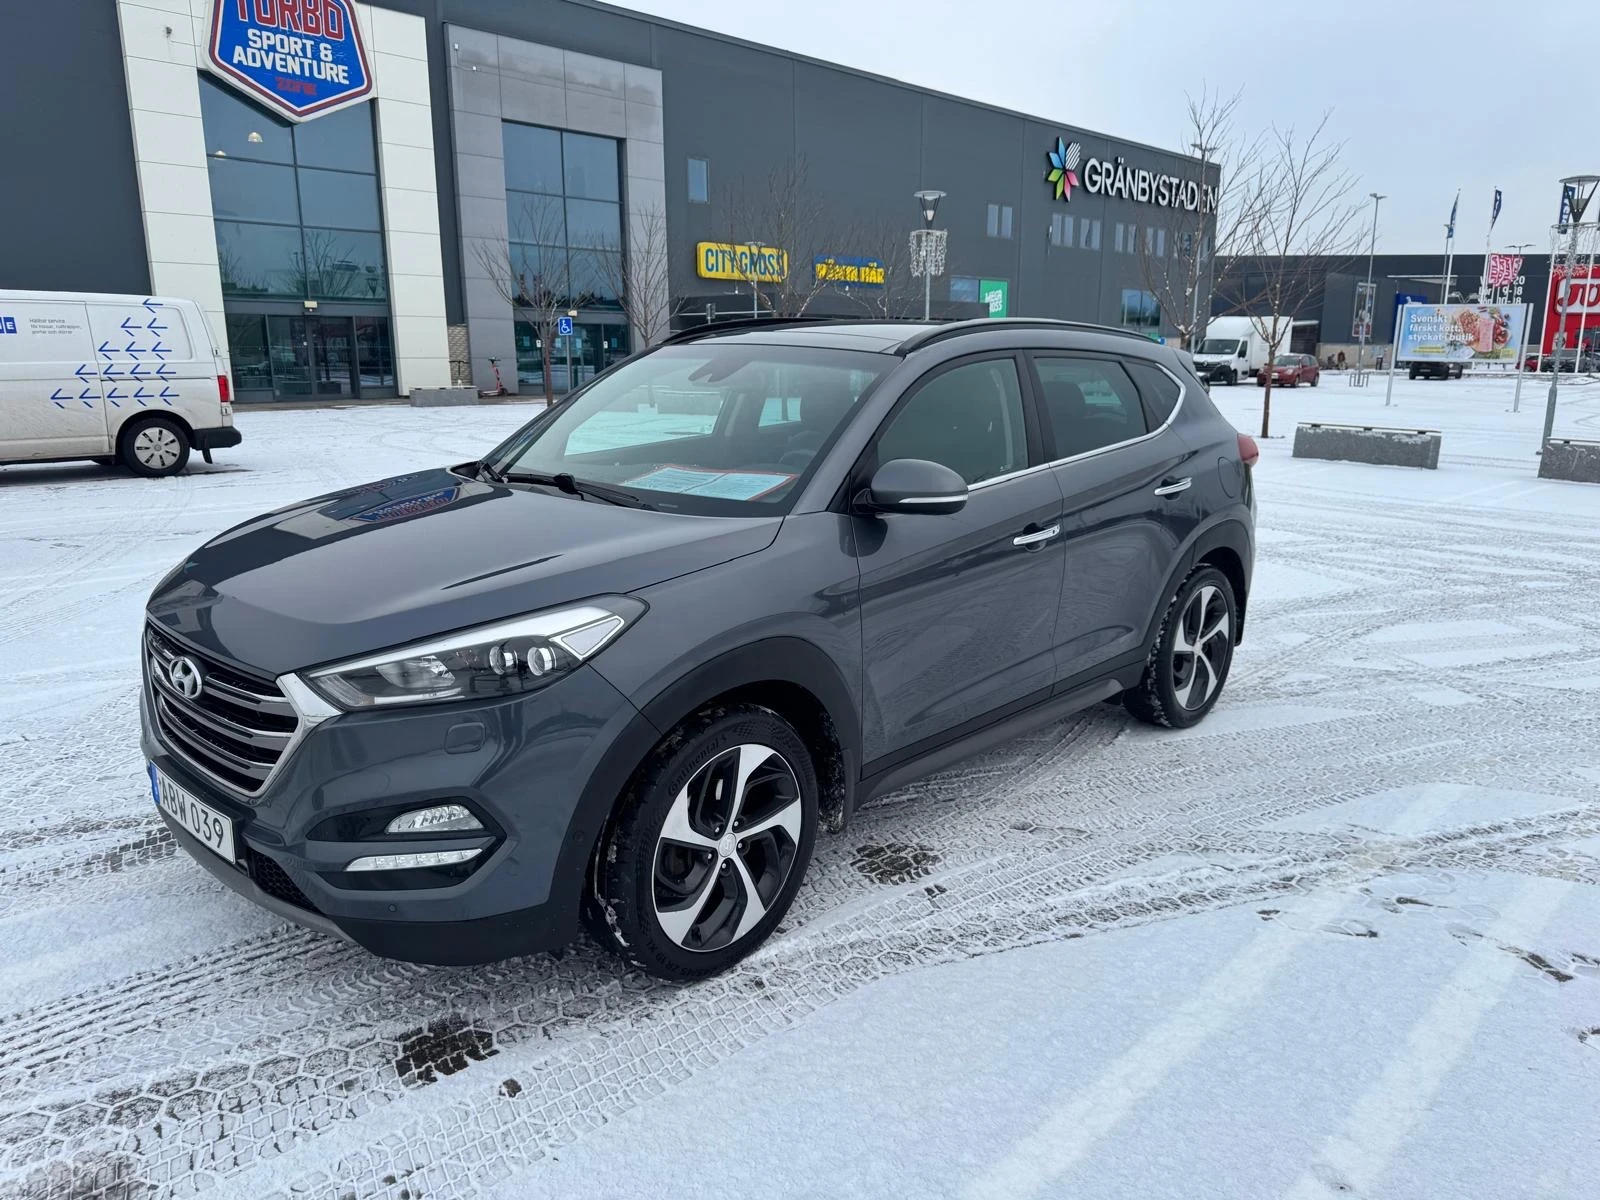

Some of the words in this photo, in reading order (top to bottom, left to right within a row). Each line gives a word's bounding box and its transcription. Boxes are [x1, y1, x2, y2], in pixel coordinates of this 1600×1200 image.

[248, 29, 314, 58] SPORT
[320, 43, 333, 62] &
[233, 45, 349, 85] ADVENTURE
[1084, 157, 1219, 214] GRÄNBYSTADEN
[705, 248, 736, 273] CITY
[1409, 324, 1437, 332] färskt
[1410, 314, 1447, 323] Svenskt
[161, 776, 187, 825] ABW
[190, 801, 225, 849] 039
